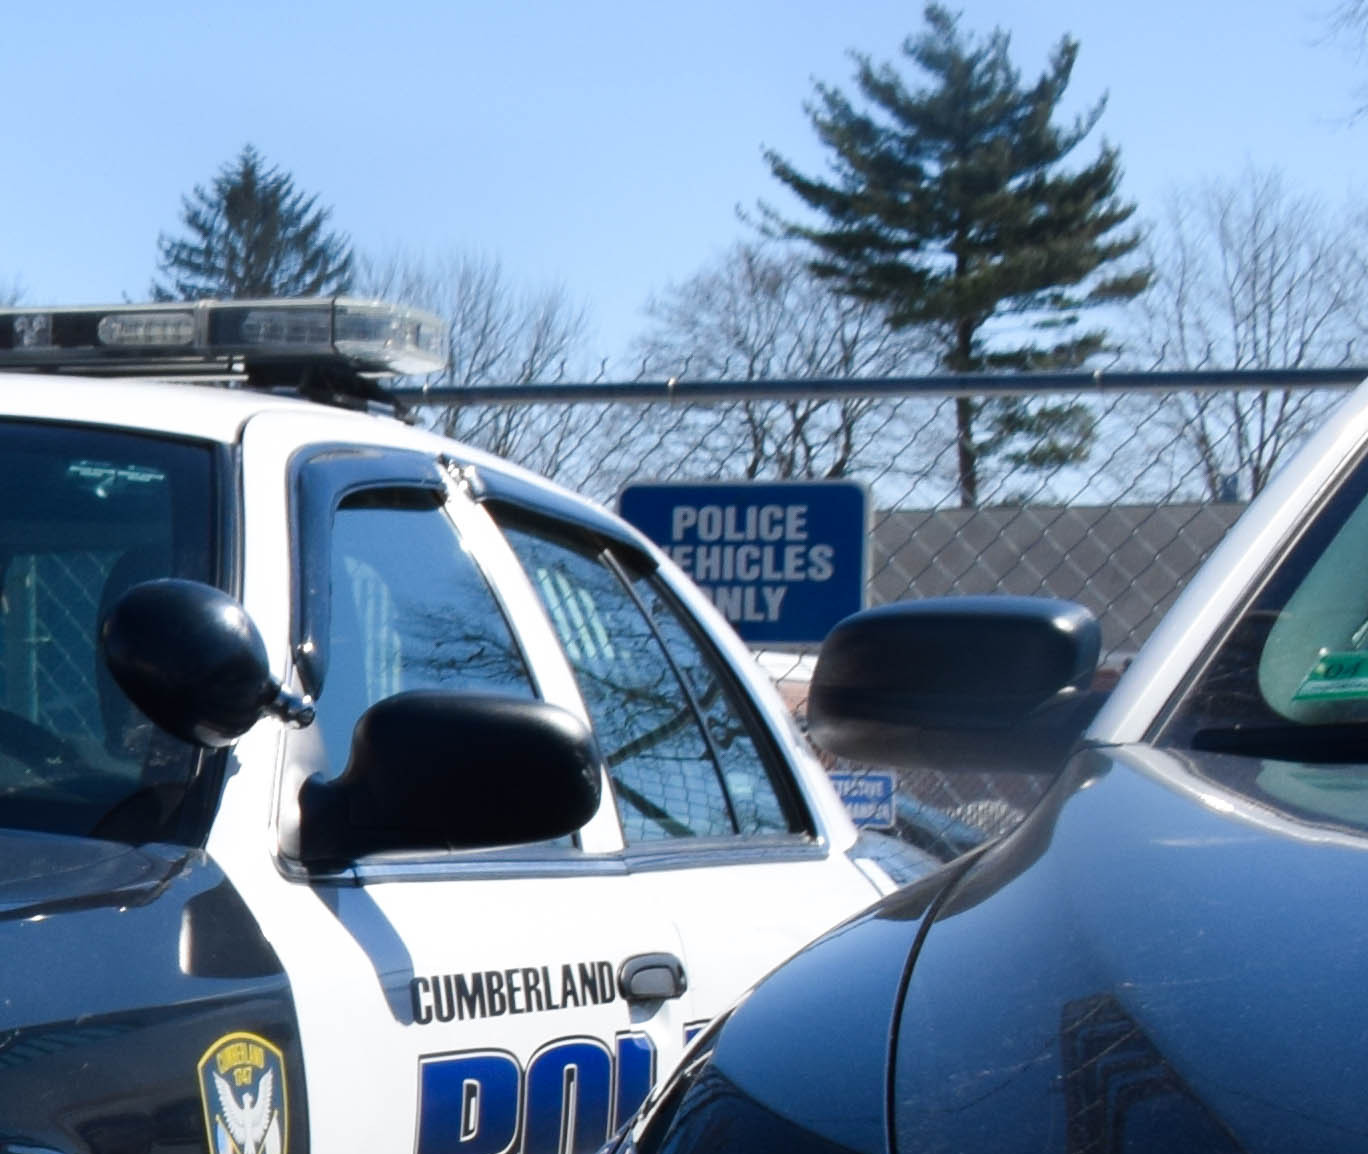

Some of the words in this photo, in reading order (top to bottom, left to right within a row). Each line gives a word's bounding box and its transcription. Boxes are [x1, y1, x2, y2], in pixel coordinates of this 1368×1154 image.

[671, 505, 809, 542] POLICE
[702, 586, 787, 622] NLY
[410, 960, 616, 1026] CUMBERLAND
